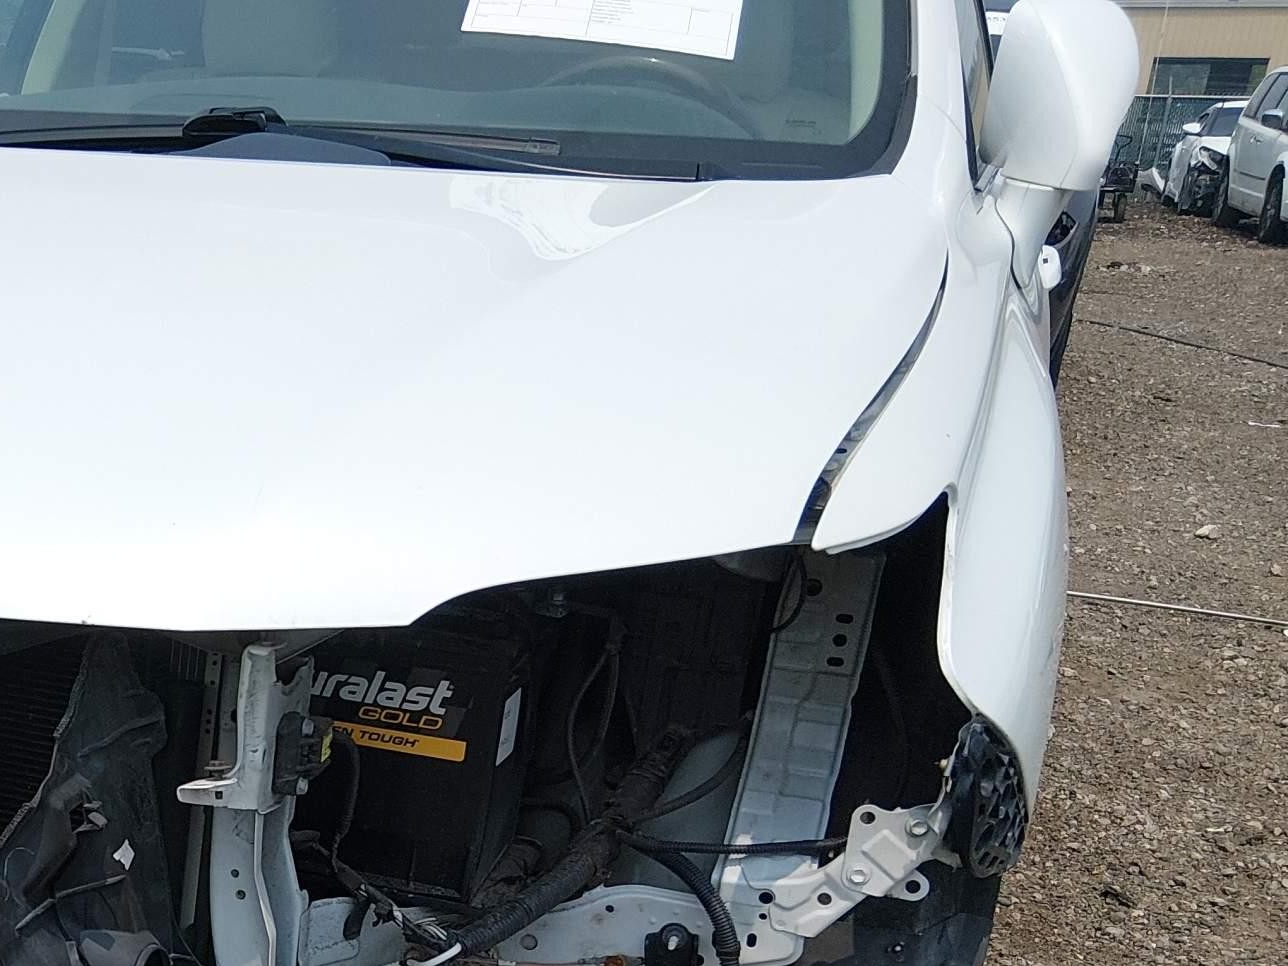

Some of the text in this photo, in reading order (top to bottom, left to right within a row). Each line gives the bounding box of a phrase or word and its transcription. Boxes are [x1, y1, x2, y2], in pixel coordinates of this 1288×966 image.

[311, 670, 453, 715] uralast
[358, 705, 443, 730] GOLD
[359, 730, 416, 748] TOUGH
